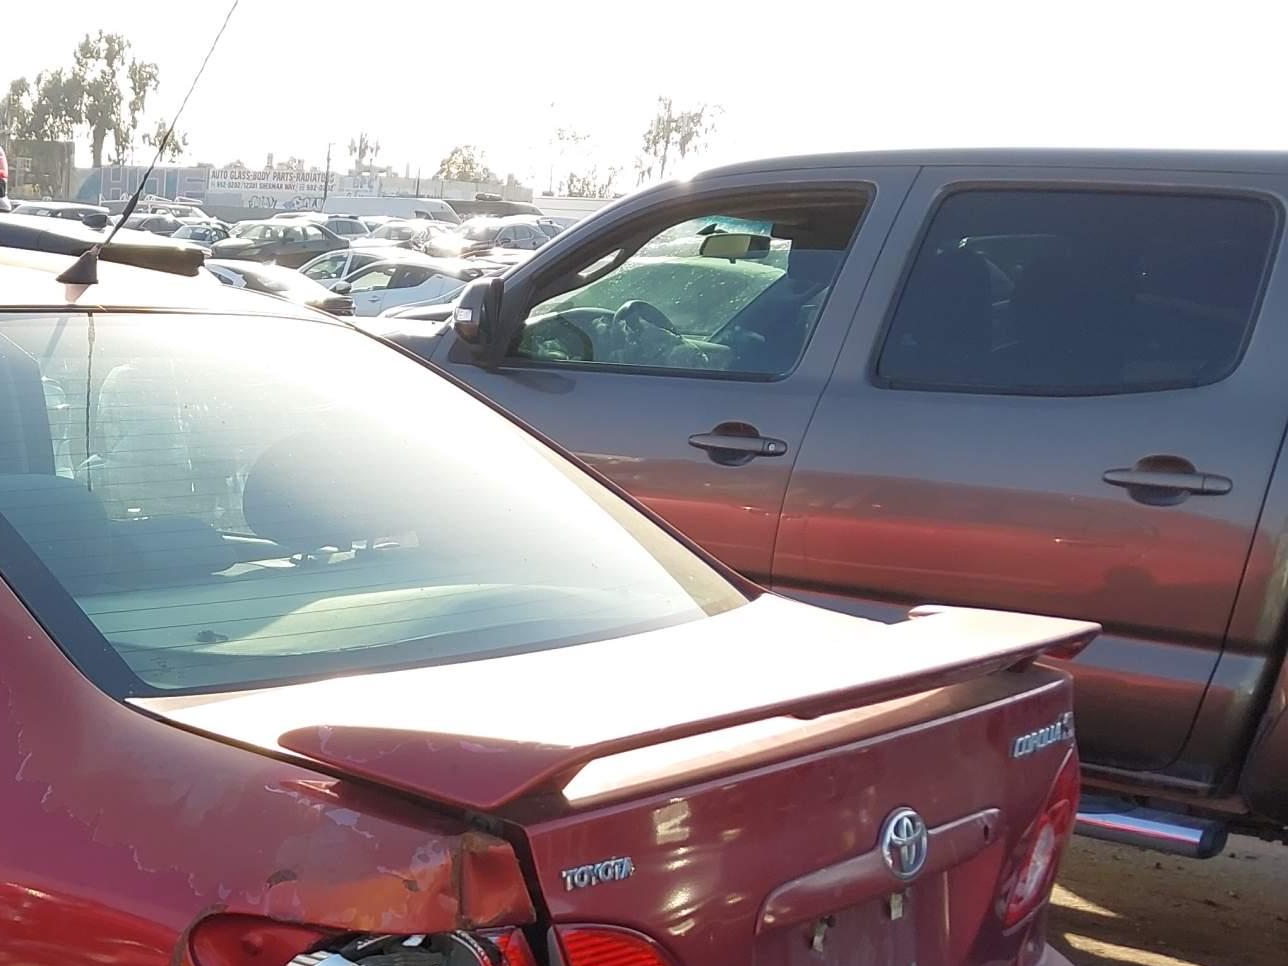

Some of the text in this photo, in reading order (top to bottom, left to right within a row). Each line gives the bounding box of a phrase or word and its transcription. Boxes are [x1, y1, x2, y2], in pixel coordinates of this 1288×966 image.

[211, 169, 228, 180] AUTO
[273, 171, 335, 184] PARTS-RADIATOS
[561, 856, 635, 892] TOYOTA
